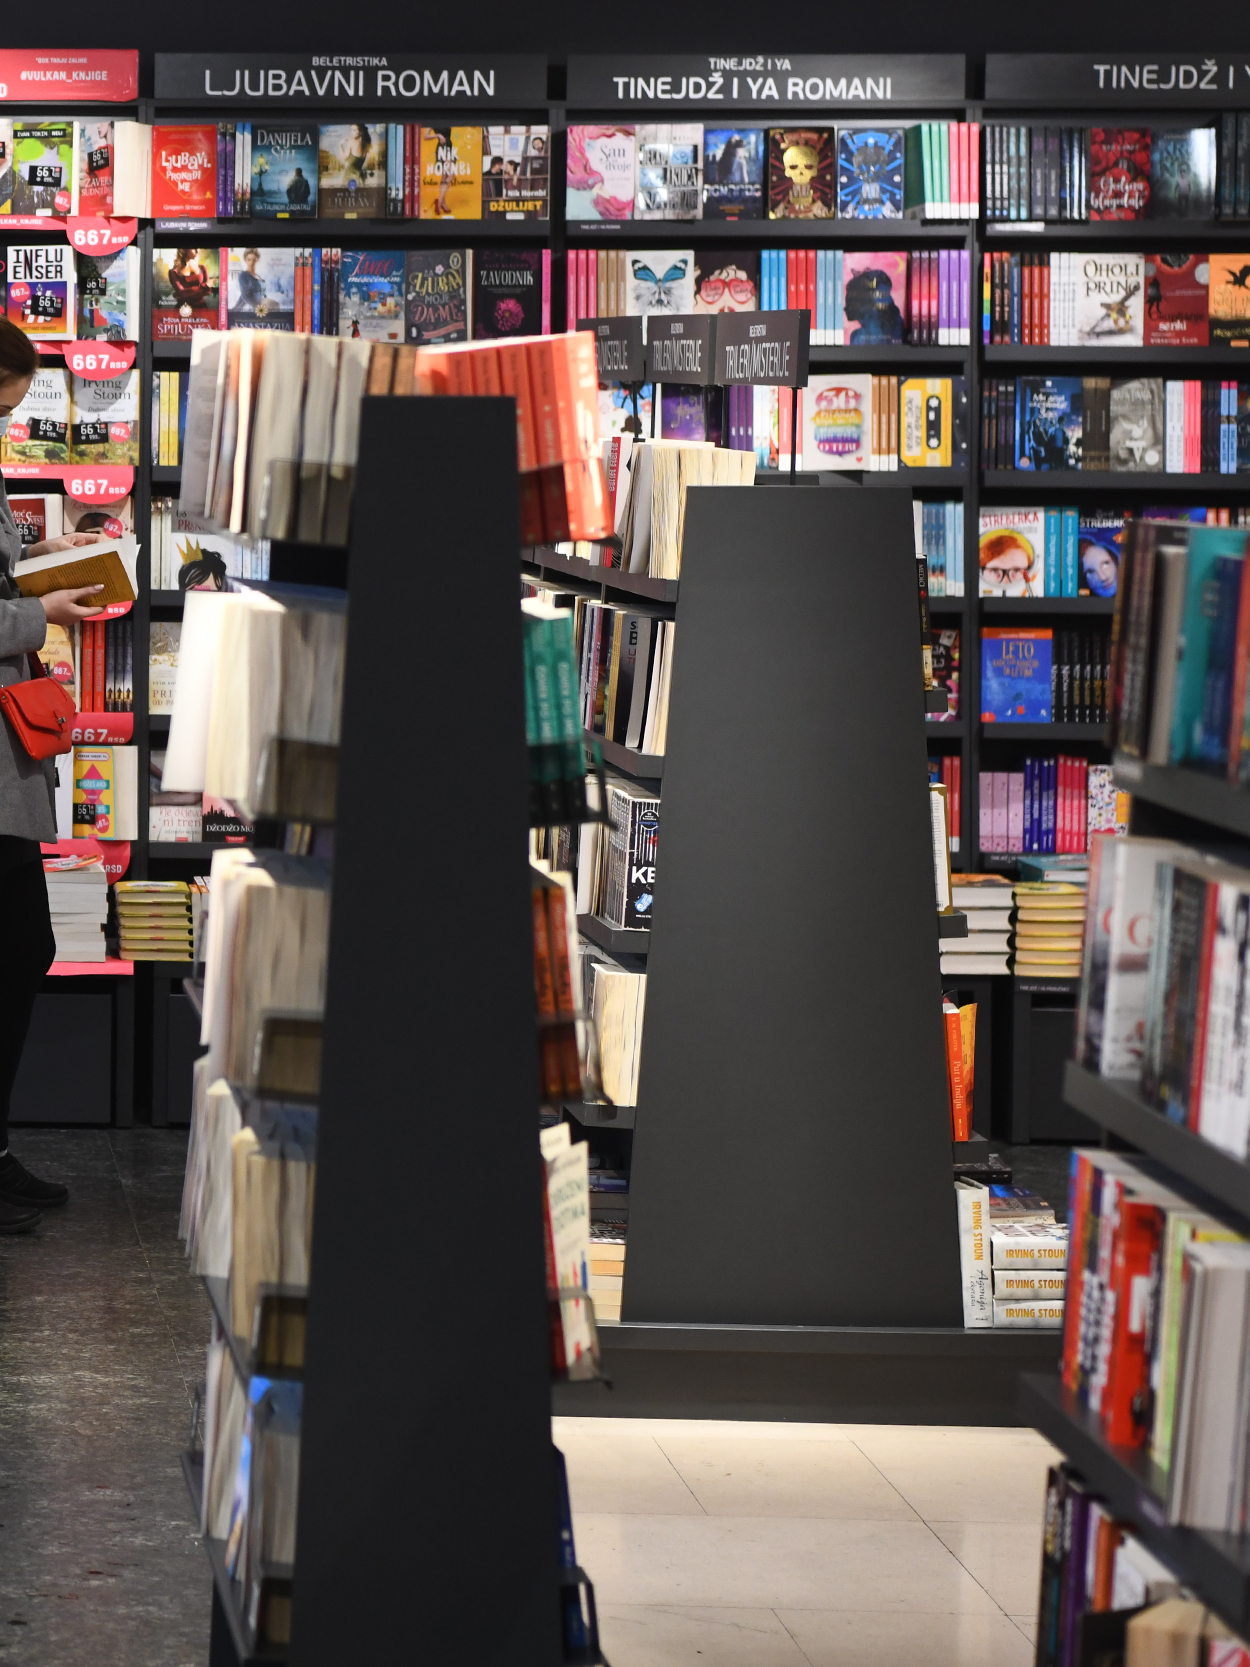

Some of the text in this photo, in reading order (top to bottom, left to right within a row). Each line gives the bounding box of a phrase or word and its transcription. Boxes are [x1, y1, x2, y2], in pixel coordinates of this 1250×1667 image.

[312, 56, 387, 67] BELETRISTIKA
[708, 55, 791, 71] TINEJDŽ I YA
[21, 71, 107, 82] #VULKAN_KNJIGE
[1093, 59, 1234, 89] TINEJDŽ I
[204, 69, 495, 97] LJUBAVNI ROMAN
[613, 71, 893, 100] TINEJDŽ I YA ROMANI
[257, 129, 313, 147] DANIJELA
[599, 145, 626, 163] San
[426, 160, 471, 176] HORNBI
[605, 160, 632, 174] dvoje
[489, 201, 543, 212] DŽULIJET
[74, 230, 129, 245] 667 RSD
[1084, 260, 1141, 279] OHOLI
[480, 270, 534, 287] ZAVODNIK
[1158, 321, 1187, 331] senki
[725, 341, 791, 382] TRILERI/MISTERIJE
[93, 387, 132, 400] Stoun
[981, 513, 1039, 529] ŠTREBERKA
[1002, 641, 1034, 657] LETO
[206, 824, 239, 833] DŽODŽO
[953, 1060, 961, 1079] Put
[954, 1085, 962, 1109] Indiju
[973, 1201, 984, 1260] IRVING STOUN
[1005, 1249, 1066, 1259] IRVING STOUN
[1005, 1279, 1066, 1289] IRVING STOUN
